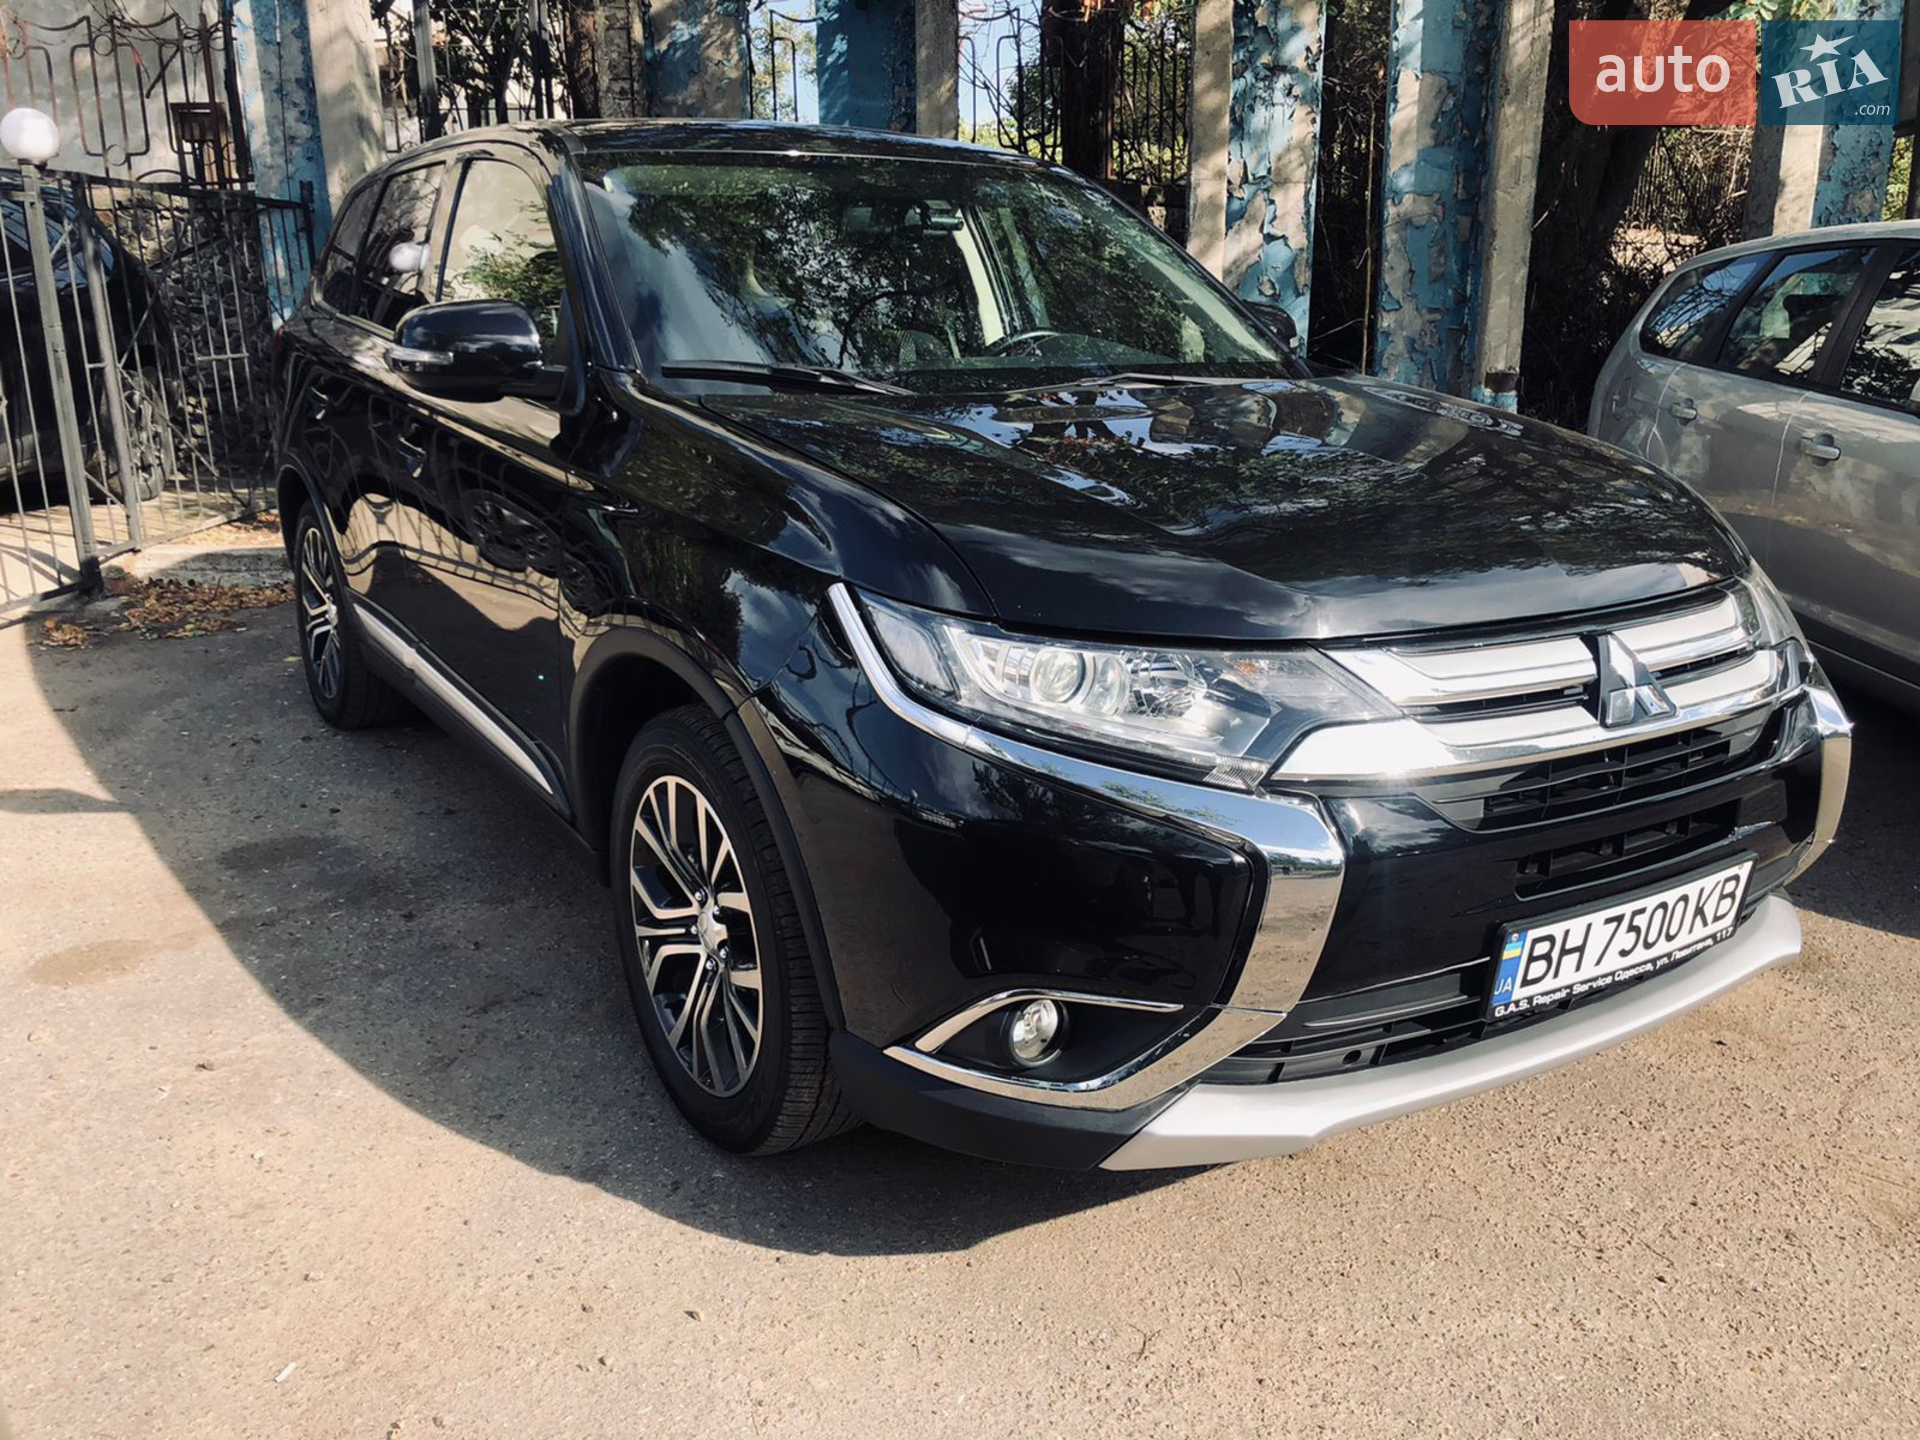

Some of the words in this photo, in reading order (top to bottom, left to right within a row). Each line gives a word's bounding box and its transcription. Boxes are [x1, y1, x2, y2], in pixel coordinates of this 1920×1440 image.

[1495, 998, 1531, 1017] G.A.S.
[1533, 988, 1570, 1007] Repair
[1572, 975, 1613, 995] Service
[1716, 926, 1734, 941] 117
[1520, 921, 1593, 989] BH
[1594, 893, 1690, 967] 7500
[1688, 873, 1741, 935] KB
[1494, 976, 1512, 995] UA
